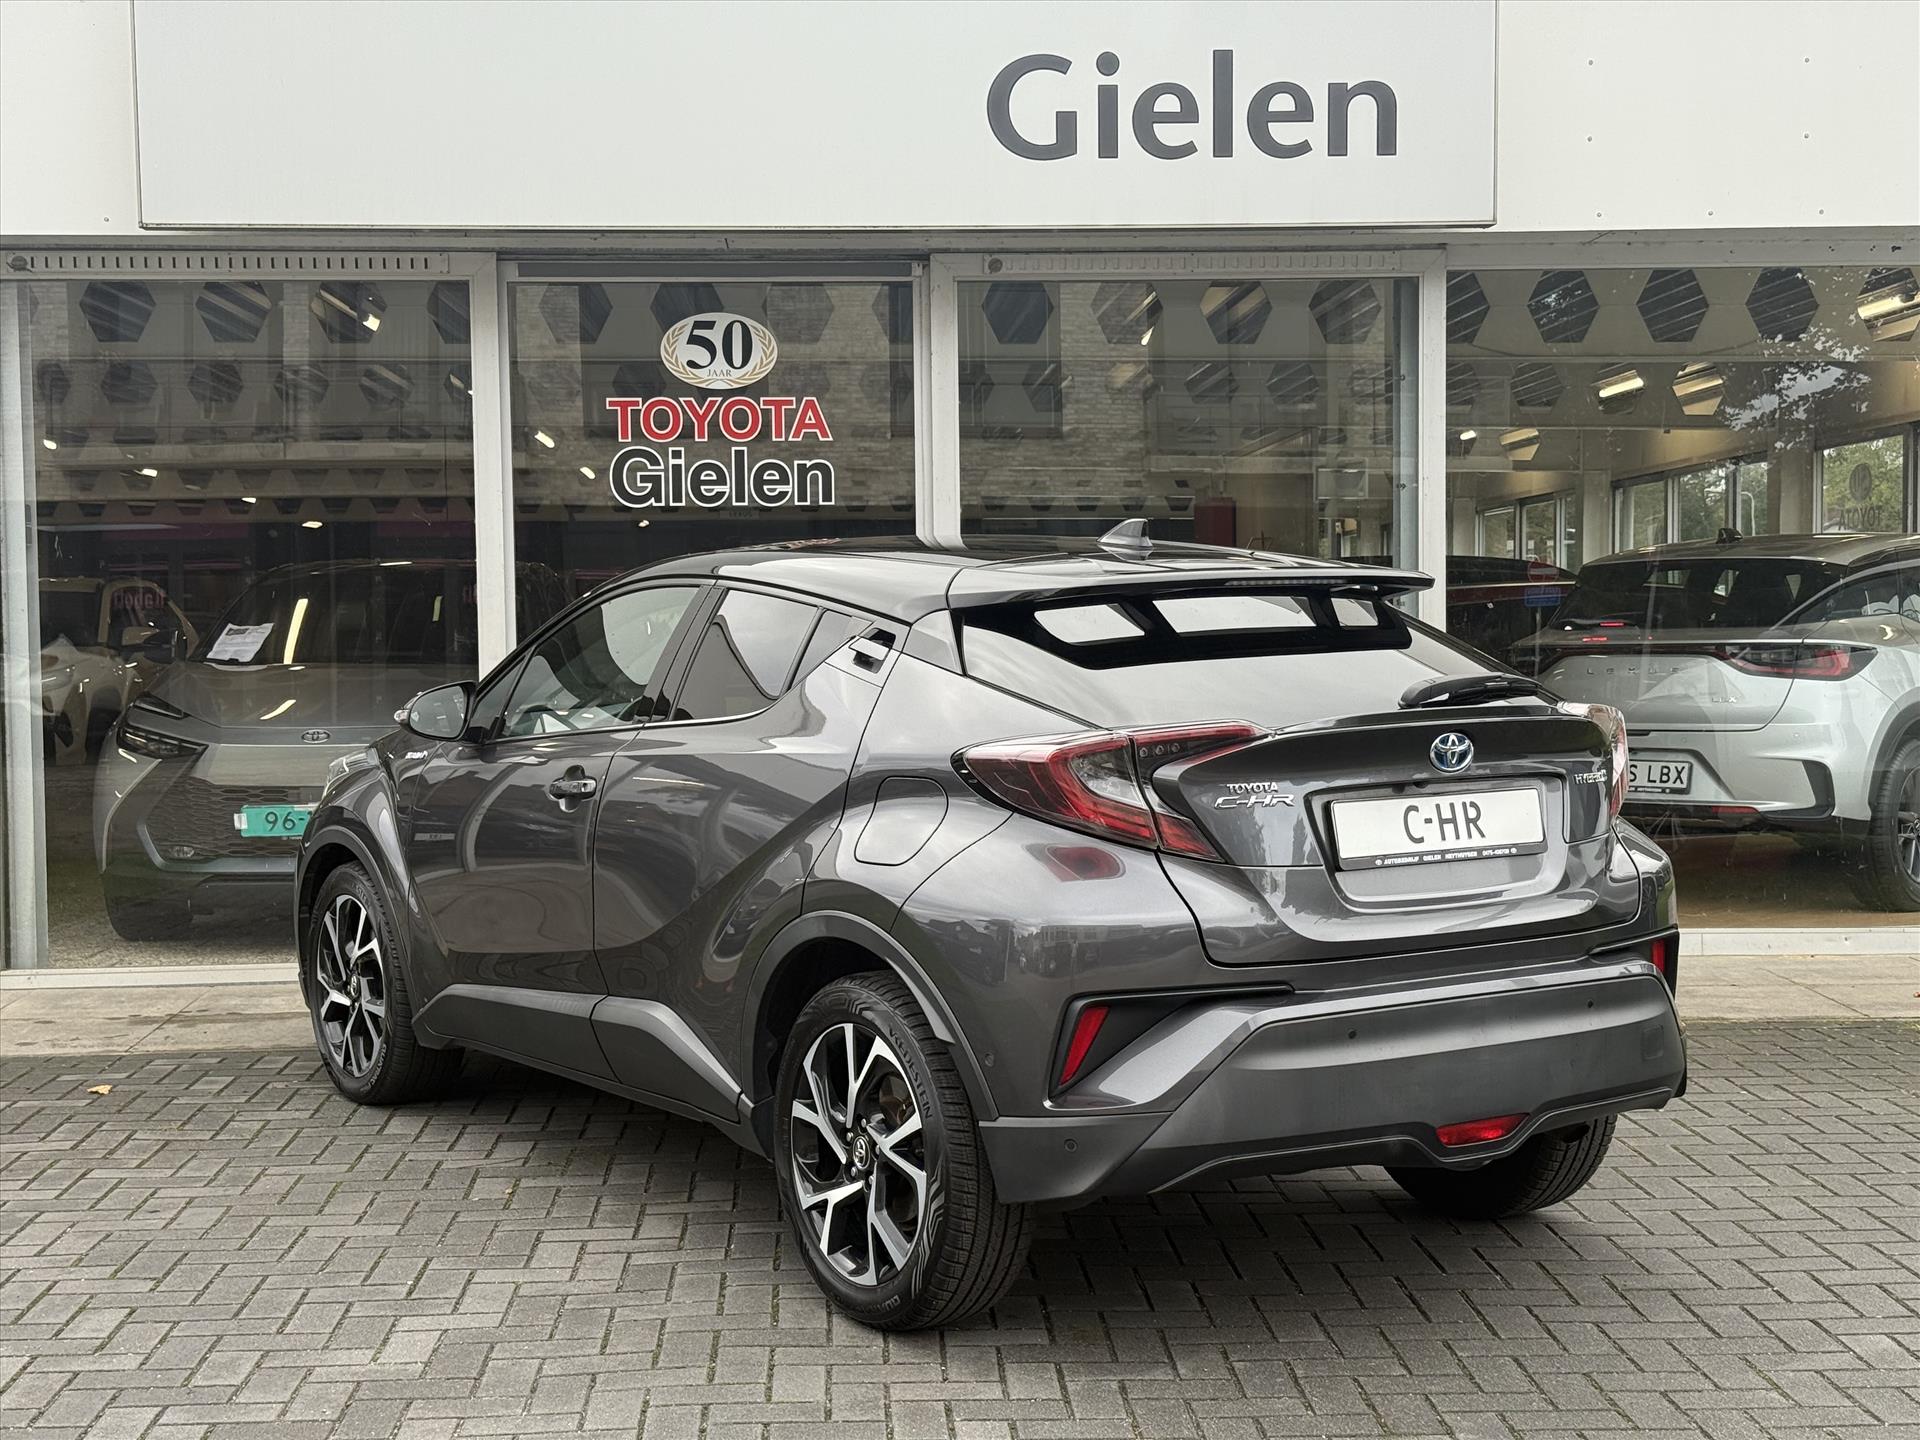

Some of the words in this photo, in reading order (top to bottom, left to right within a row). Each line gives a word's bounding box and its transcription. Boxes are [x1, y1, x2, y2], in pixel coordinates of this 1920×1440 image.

[987, 49, 1398, 161] Gielen
[685, 319, 753, 370] 50
[706, 368, 732, 378] JAAR
[606, 396, 834, 442] TOYOTA
[609, 445, 836, 509] Gielen
[1226, 781, 1279, 794] TOYOTA
[1647, 764, 1686, 785] LBX
[1213, 794, 1296, 809] C-HR
[1403, 800, 1486, 844] C-HR
